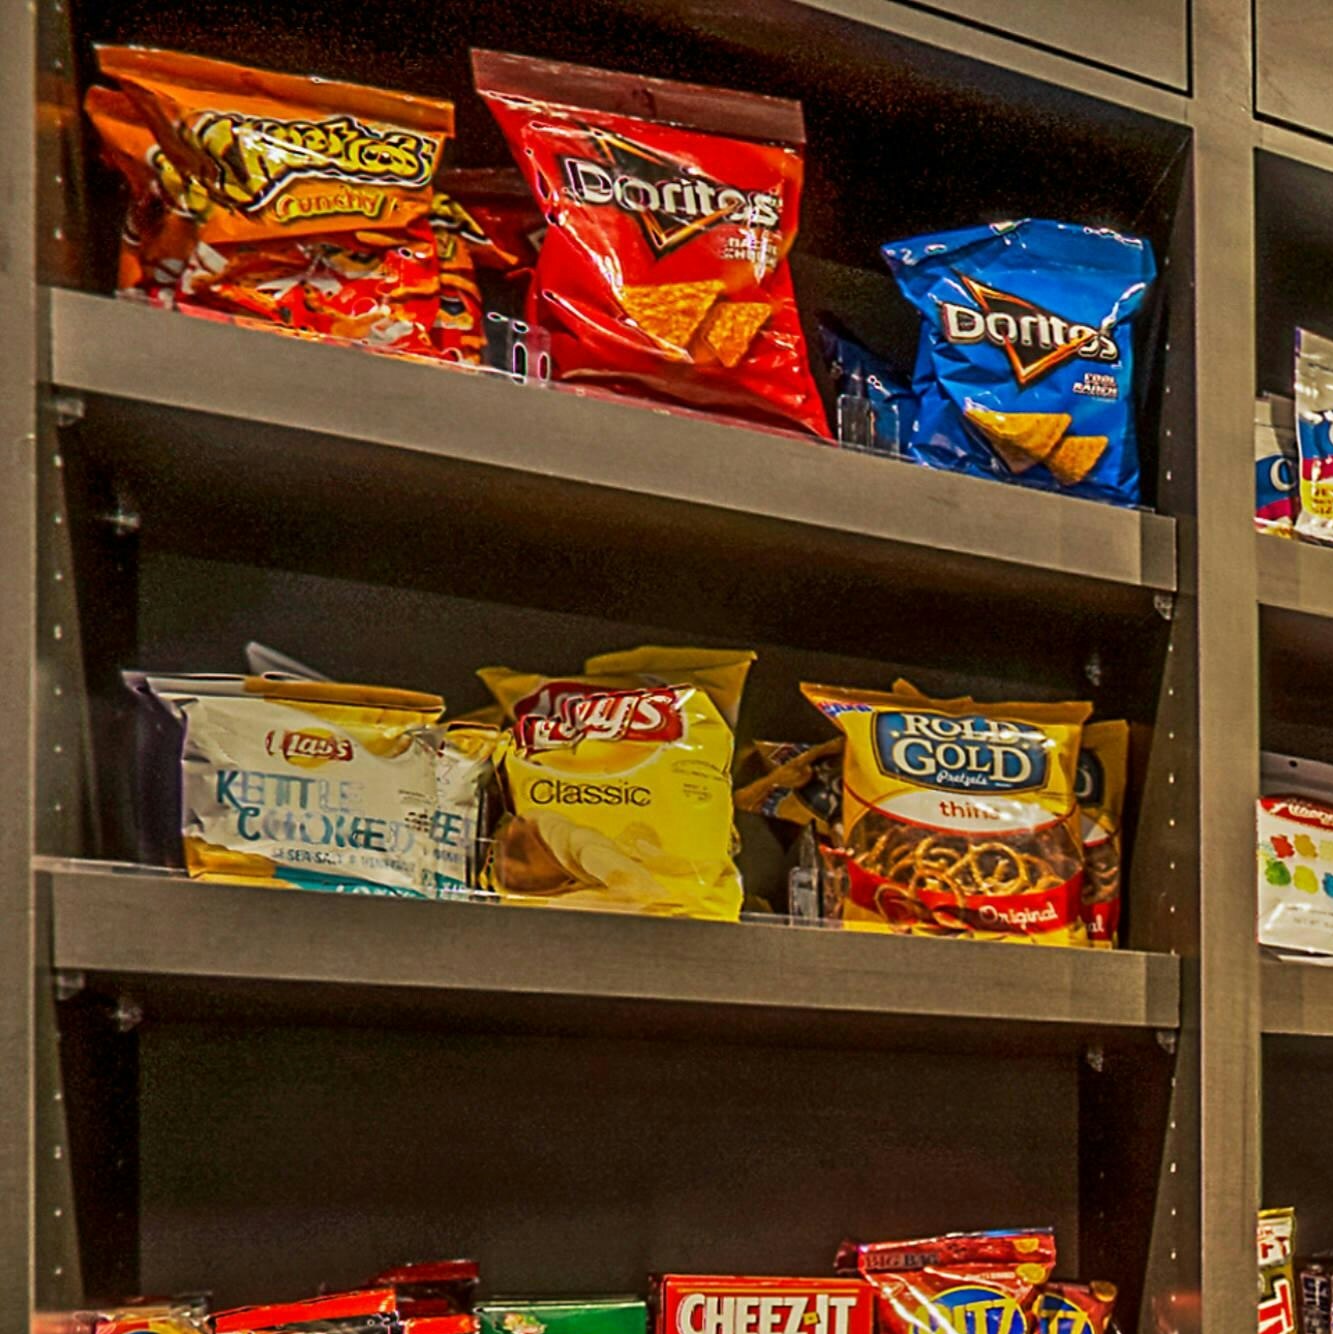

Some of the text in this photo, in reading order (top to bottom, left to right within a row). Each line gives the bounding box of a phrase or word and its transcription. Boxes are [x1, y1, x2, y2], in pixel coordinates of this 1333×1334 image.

[563, 156, 780, 228] Doritos
[942, 303, 1120, 360] Doritos
[902, 713, 1016, 745] ROLD
[892, 738, 1034, 784] GOLD
[216, 769, 363, 812] KETTLE
[529, 778, 653, 808] Classic
[237, 805, 416, 853] COOKED
[978, 903, 1059, 925] Original
